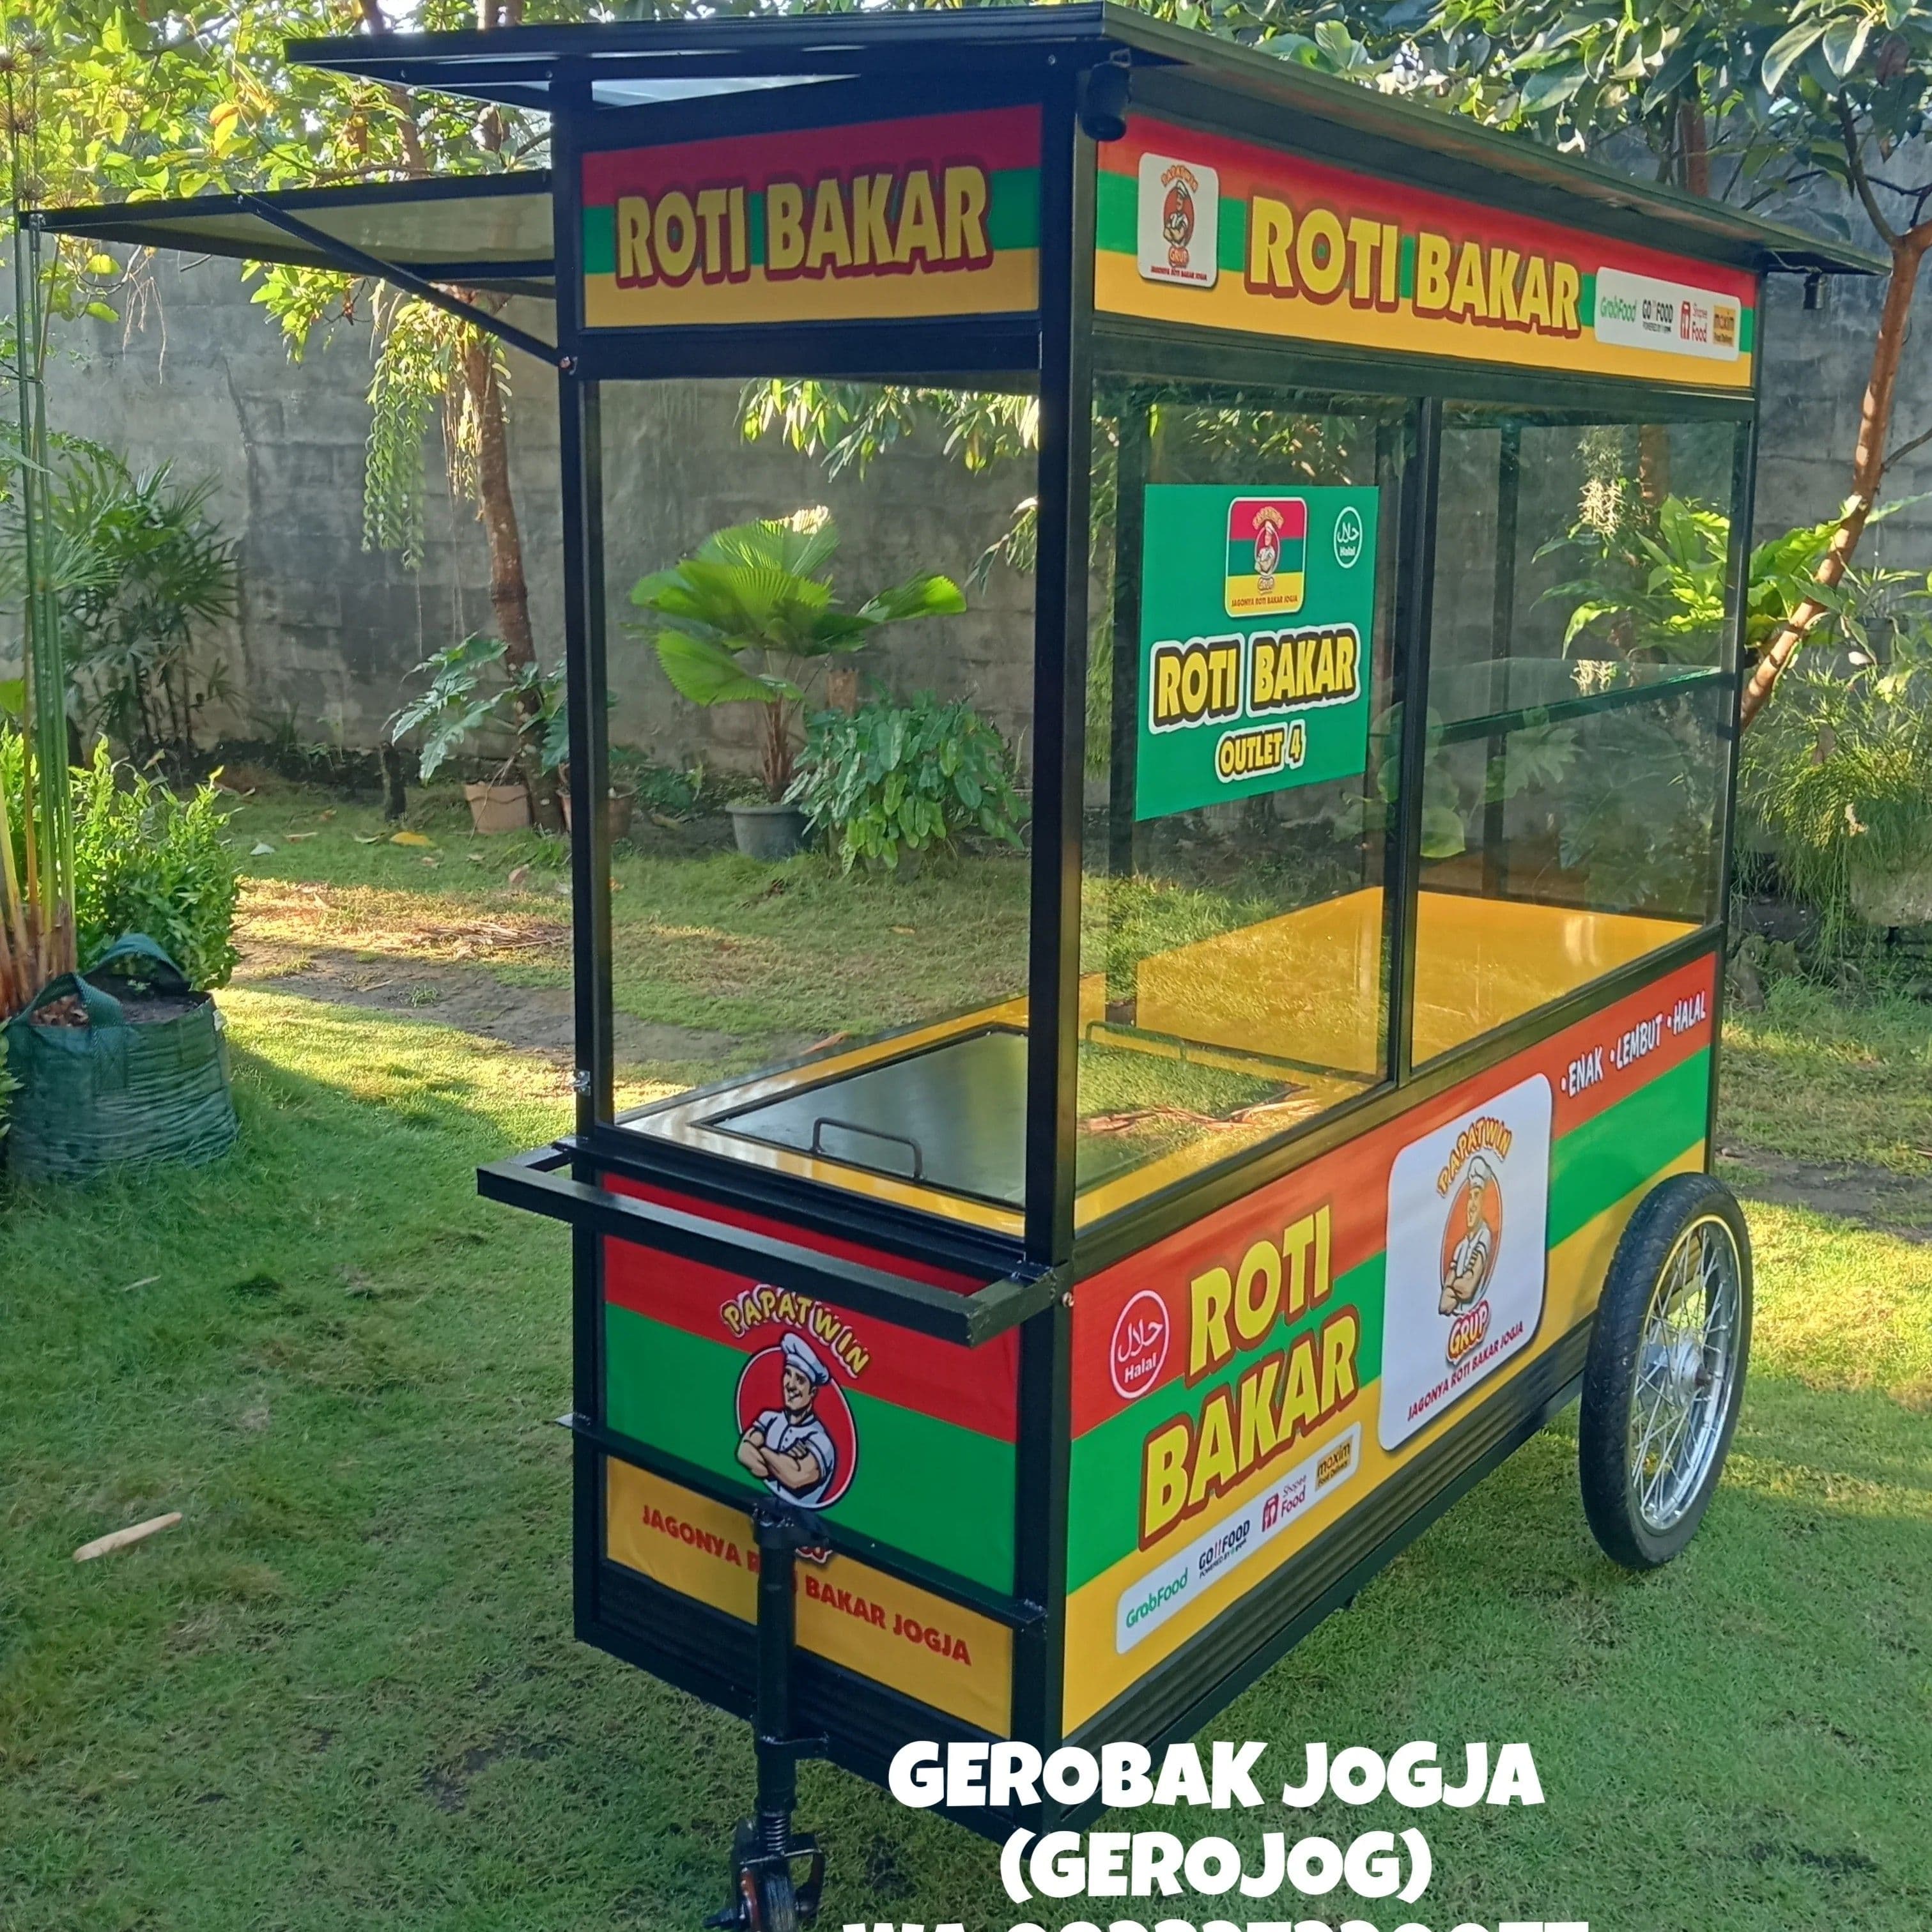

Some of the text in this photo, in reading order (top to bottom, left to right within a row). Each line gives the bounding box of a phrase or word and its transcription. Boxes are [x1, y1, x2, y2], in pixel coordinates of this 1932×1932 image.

[615, 164, 989, 281] ROTI BAKAR
[1249, 195, 1580, 331] ROTI BAKAR
[1157, 635, 1355, 719] ROTI BAKAR
[1219, 725, 1302, 775] OUTLET 4
[1437, 1116, 1512, 1198] PAPATWIN
[721, 1285, 871, 1378] PAPATWIN
[1189, 1204, 1331, 1376] ROTI
[1448, 1300, 1490, 1361] GRUP
[1124, 1352, 1157, 1384] Halal
[1407, 1320, 1524, 1422] JAGONYA ROTI BAKAR JOGJA
[1143, 1314, 1357, 1541] BAKAR
[1317, 1442, 1350, 1478] maxim
[1281, 1484, 1306, 1518] Food
[642, 1504, 742, 1566] JAGONYA
[805, 1575, 886, 1630] BAKAR
[892, 1612, 972, 1667] JOGJA
[1125, 1566, 1189, 1628] GrabFood
